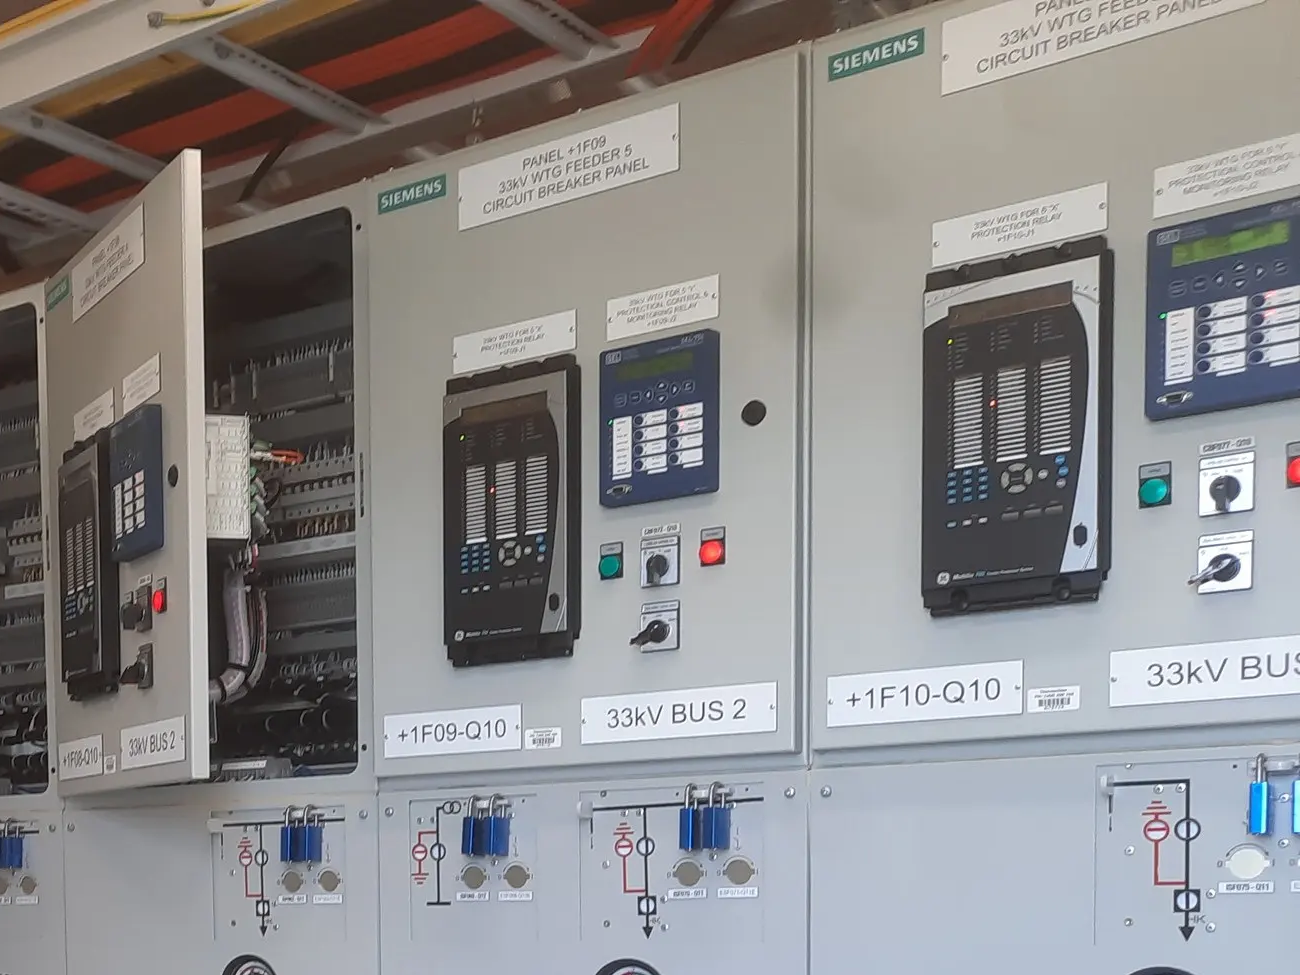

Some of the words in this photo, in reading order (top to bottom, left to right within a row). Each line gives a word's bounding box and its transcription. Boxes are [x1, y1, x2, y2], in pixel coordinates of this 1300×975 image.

[999, 22, 1043, 48] 33kV
[1047, 7, 1091, 34] WTG
[1098, 0, 1158, 18] FEED
[1034, 0, 1092, 18] PAN
[832, 34, 919, 75] SIEMENS
[976, 38, 1051, 74] CIRCUIT
[1056, 9, 1150, 51] BREAKER
[522, 149, 564, 171] PANEL
[568, 134, 607, 157] +1F09
[498, 174, 529, 195] 33kV
[532, 166, 563, 186] WTG
[565, 148, 621, 176] FEEDER
[624, 144, 633, 158] 5
[380, 180, 443, 210] SIEMENS
[482, 189, 536, 215] CIRCUIT
[538, 174, 601, 200] BREAKER
[605, 158, 650, 181] PANEL
[1147, 657, 1228, 687] 33kV
[846, 677, 1001, 709] +1F10-Q10
[607, 704, 663, 729] 33kV
[672, 700, 724, 724] BUS
[732, 698, 747, 720] 2
[128, 737, 149, 758] 33kV
[150, 731, 168, 754] BUS
[170, 730, 176, 750] 2
[397, 718, 507, 744] +1F09-Q10
